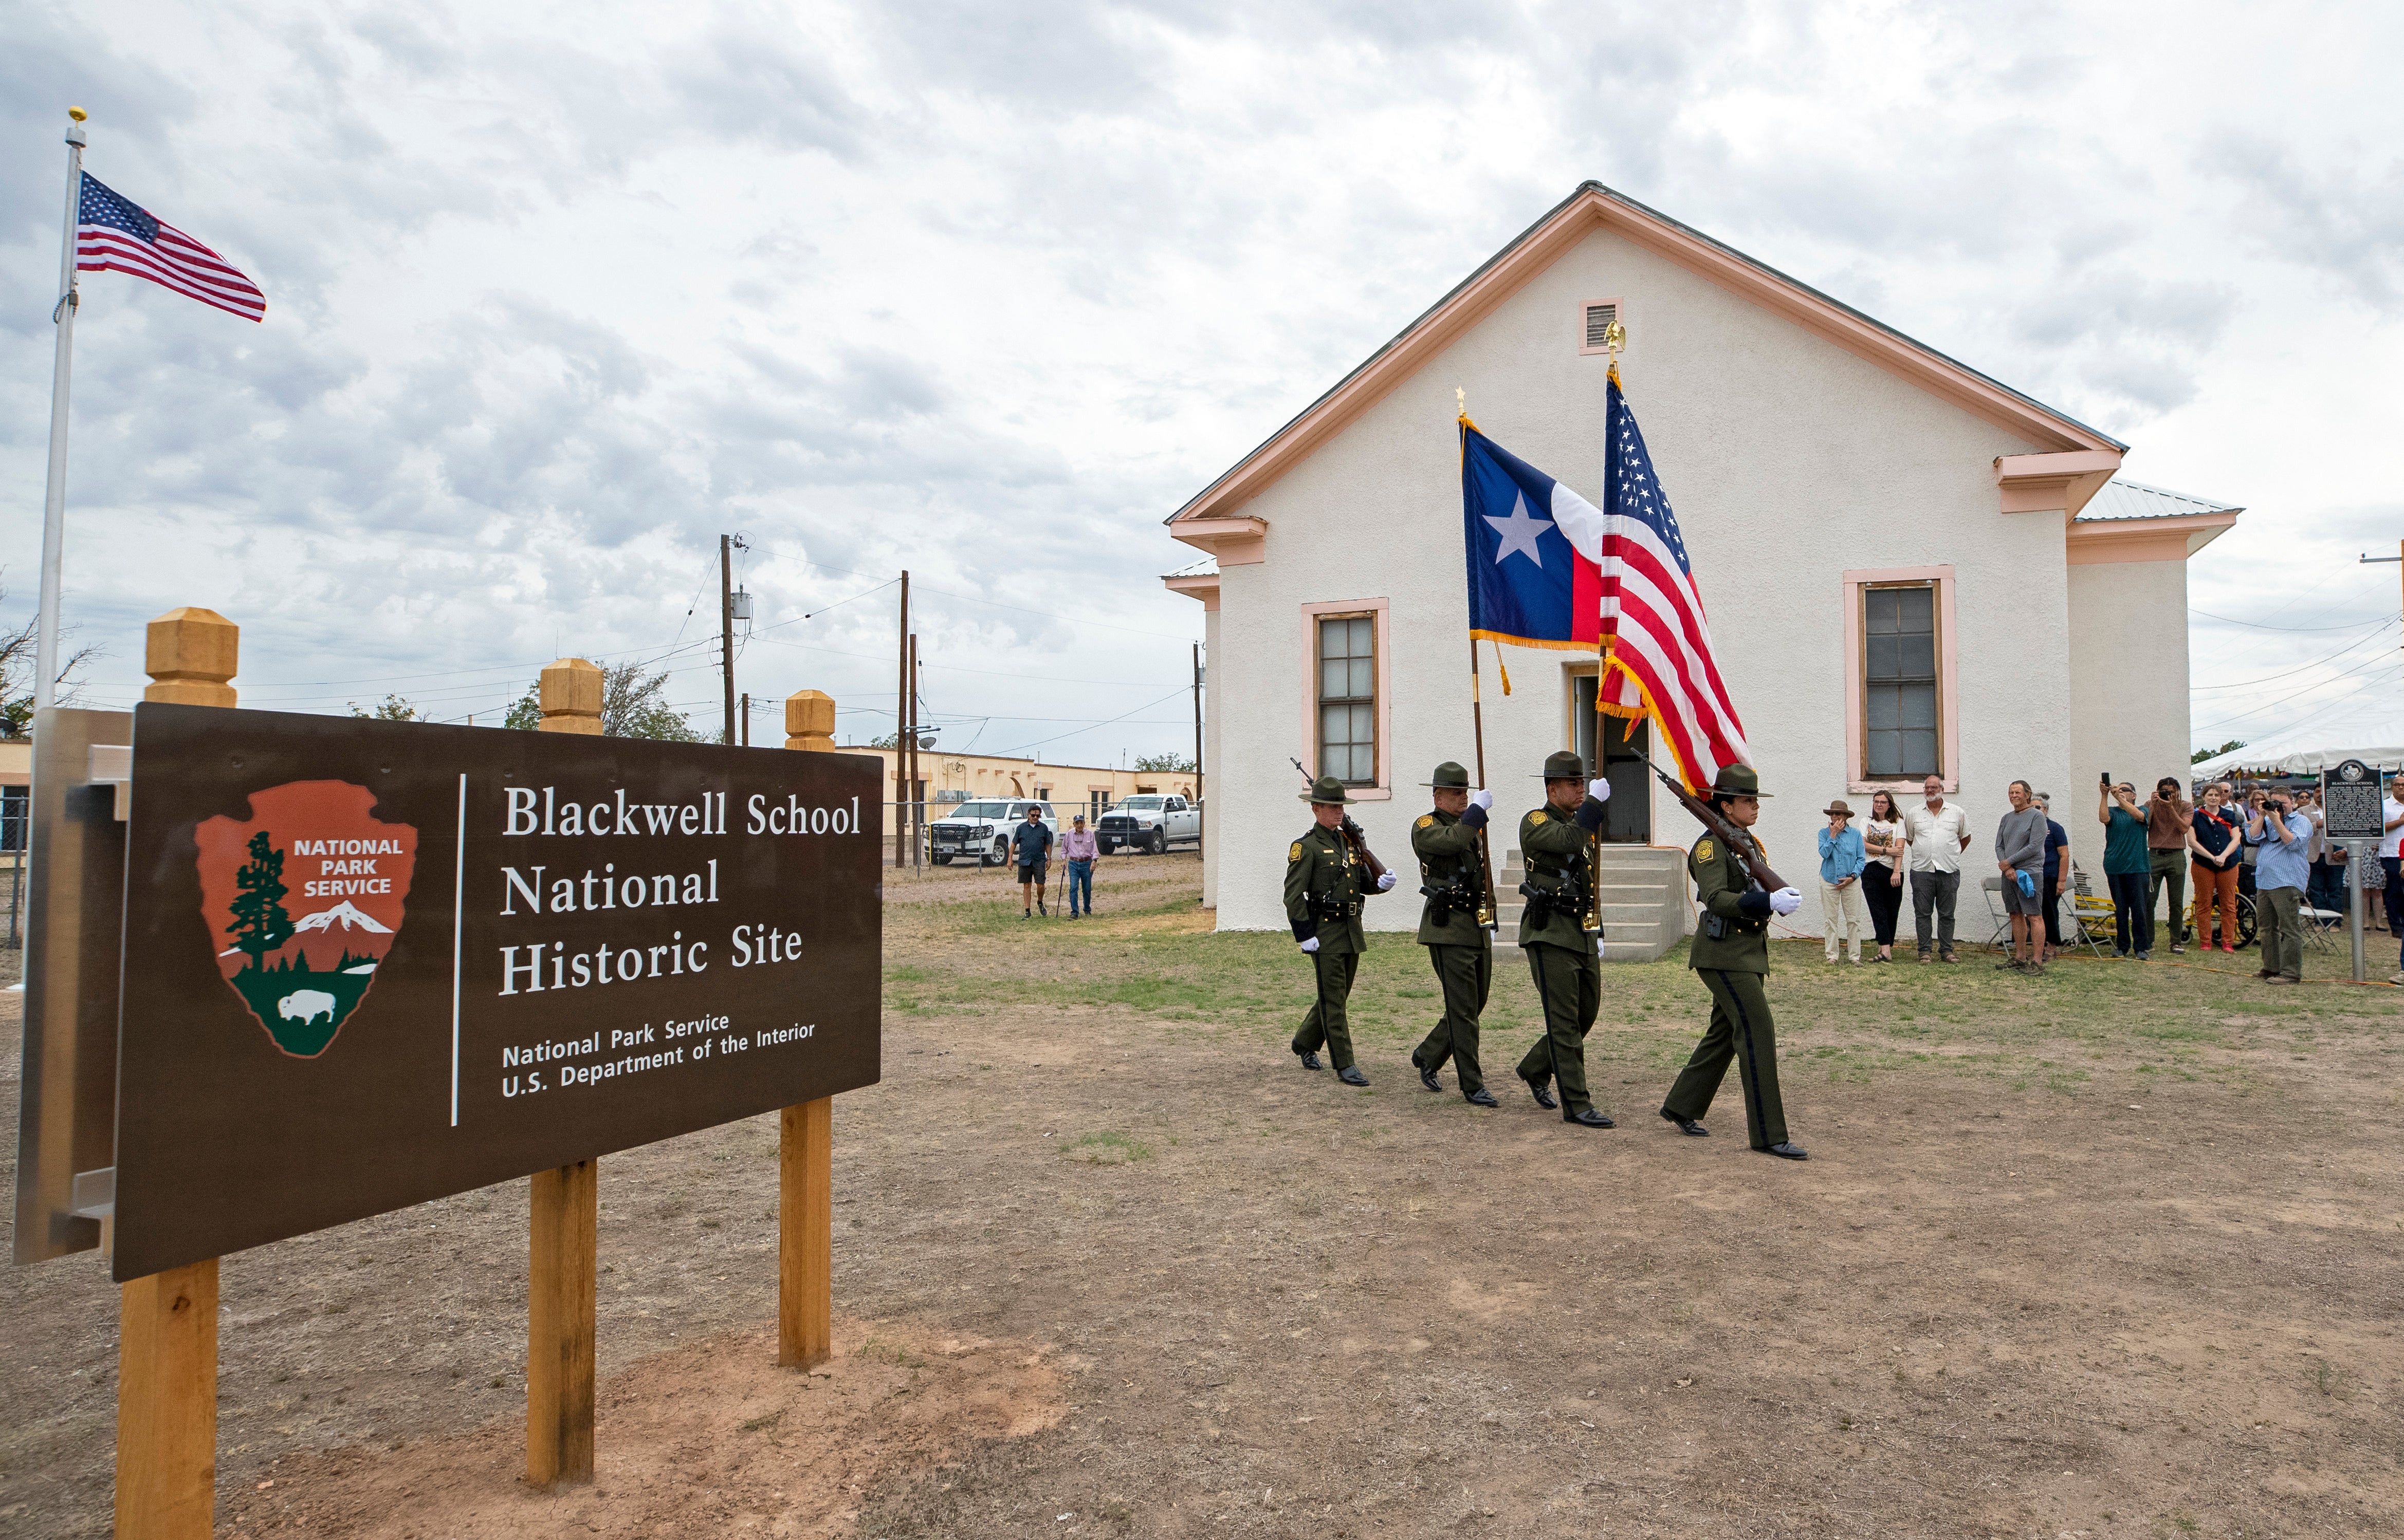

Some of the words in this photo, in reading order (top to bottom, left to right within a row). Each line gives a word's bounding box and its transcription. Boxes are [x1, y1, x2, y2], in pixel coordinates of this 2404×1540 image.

[503, 787, 726, 836] Blackwell
[748, 794, 860, 834] School
[295, 840, 403, 856] NATIONAL
[322, 860, 377, 875] PARK
[305, 879, 391, 897] SERVICE
[500, 859, 719, 915] National
[499, 931, 707, 995] Historic
[732, 924, 801, 967] Site
[503, 1032, 598, 1067] National
[612, 1024, 654, 1048] Park
[666, 1014, 728, 1038] Service
[503, 1072, 547, 1097] U.S.
[561, 1047, 683, 1086] Department
[693, 1038, 711, 1059] of
[721, 1035, 747, 1054] the
[758, 1023, 814, 1047] Interior
